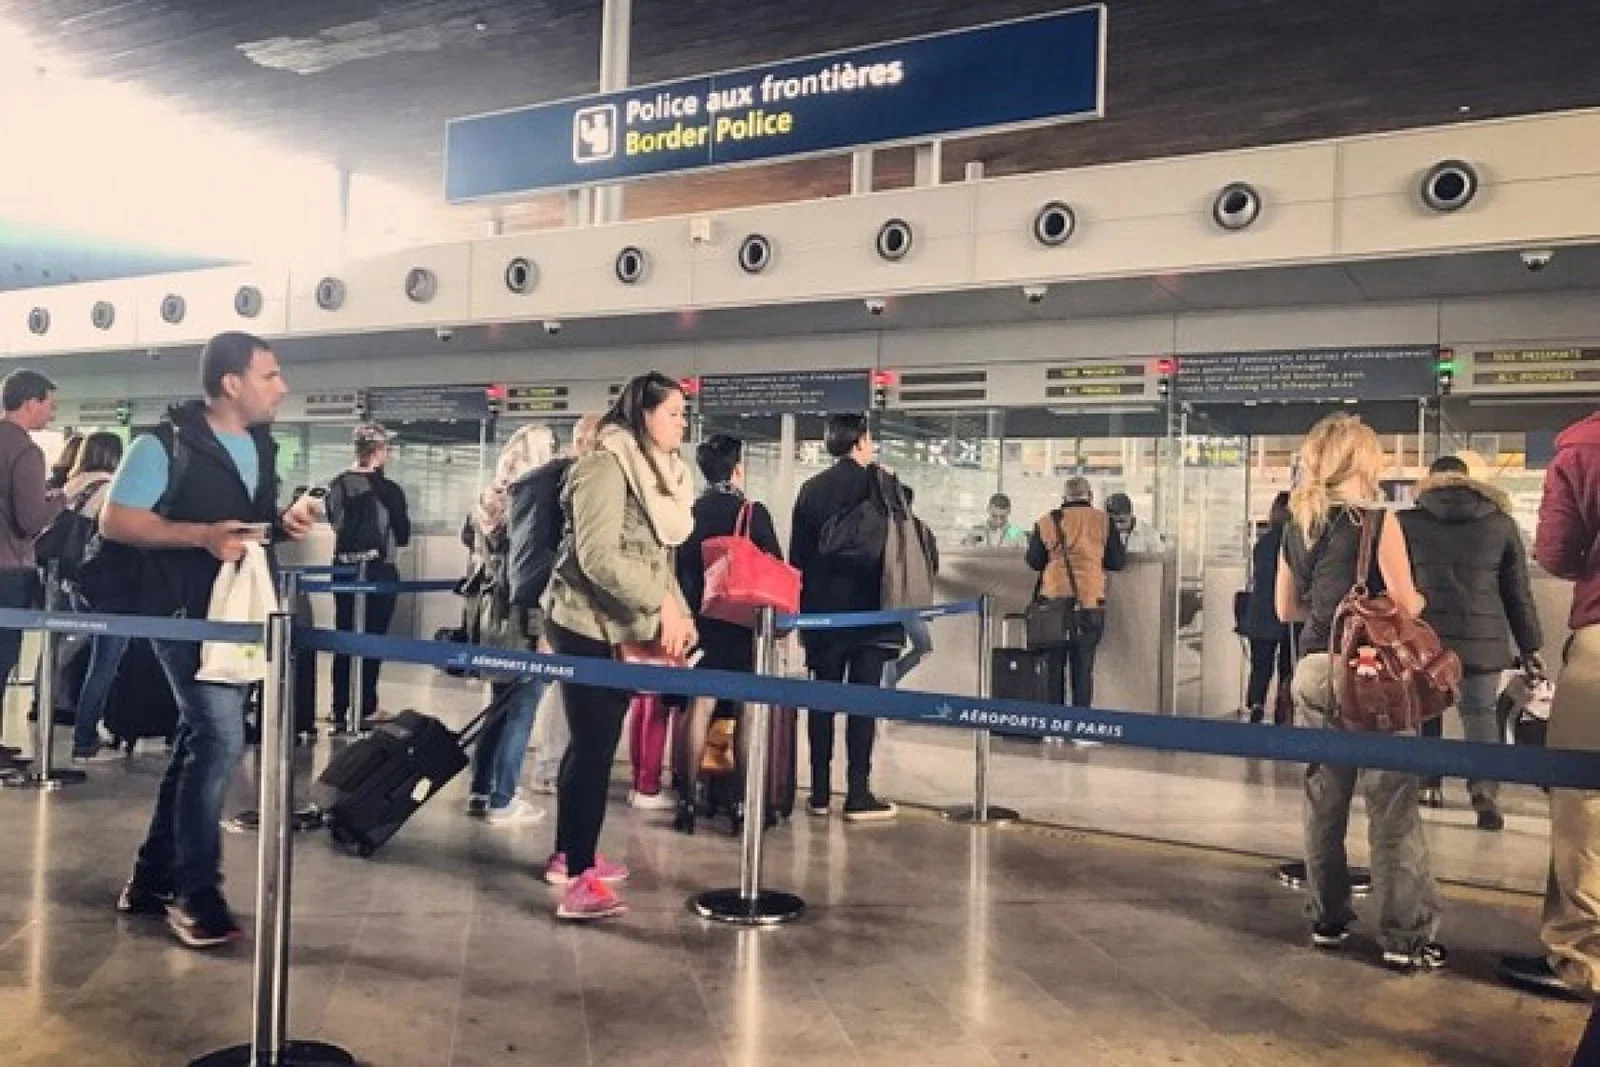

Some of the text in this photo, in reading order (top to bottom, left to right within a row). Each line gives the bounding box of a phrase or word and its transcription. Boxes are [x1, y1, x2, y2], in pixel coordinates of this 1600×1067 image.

[626, 60, 904, 124] Police aux frontières
[626, 110, 793, 155] Border Police
[1051, 719, 1073, 732] DE
[1077, 721, 1124, 737] PARIS
